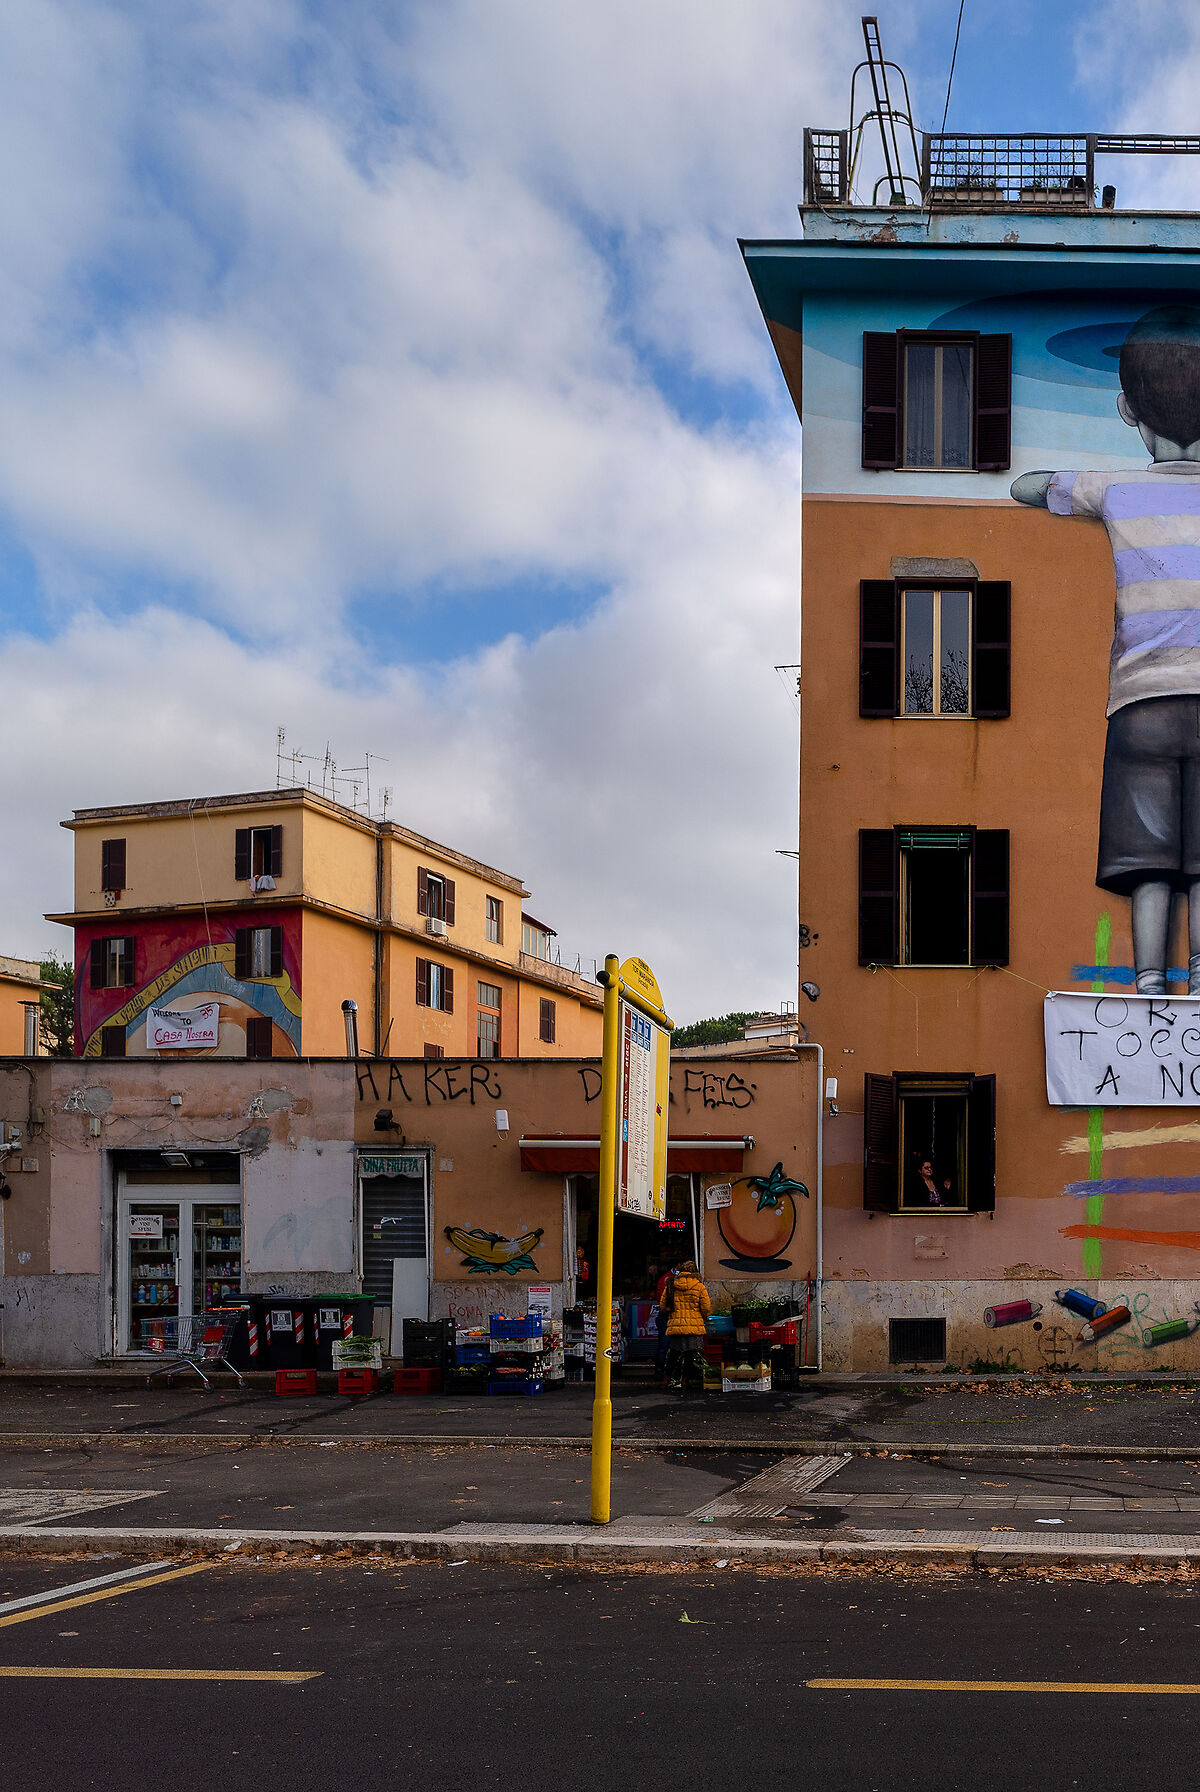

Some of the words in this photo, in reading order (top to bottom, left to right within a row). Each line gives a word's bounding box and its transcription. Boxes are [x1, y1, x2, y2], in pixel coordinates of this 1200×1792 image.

[180, 1017, 192, 1026] TO
[154, 1027, 182, 1043] CASA
[185, 1027, 214, 1040] NOSTRA
[1095, 1064, 1121, 1096] A
[363, 1158, 386, 1173] DINA
[386, 1158, 419, 1173] FRUTTA
[658, 1221, 684, 1229] APERTO
